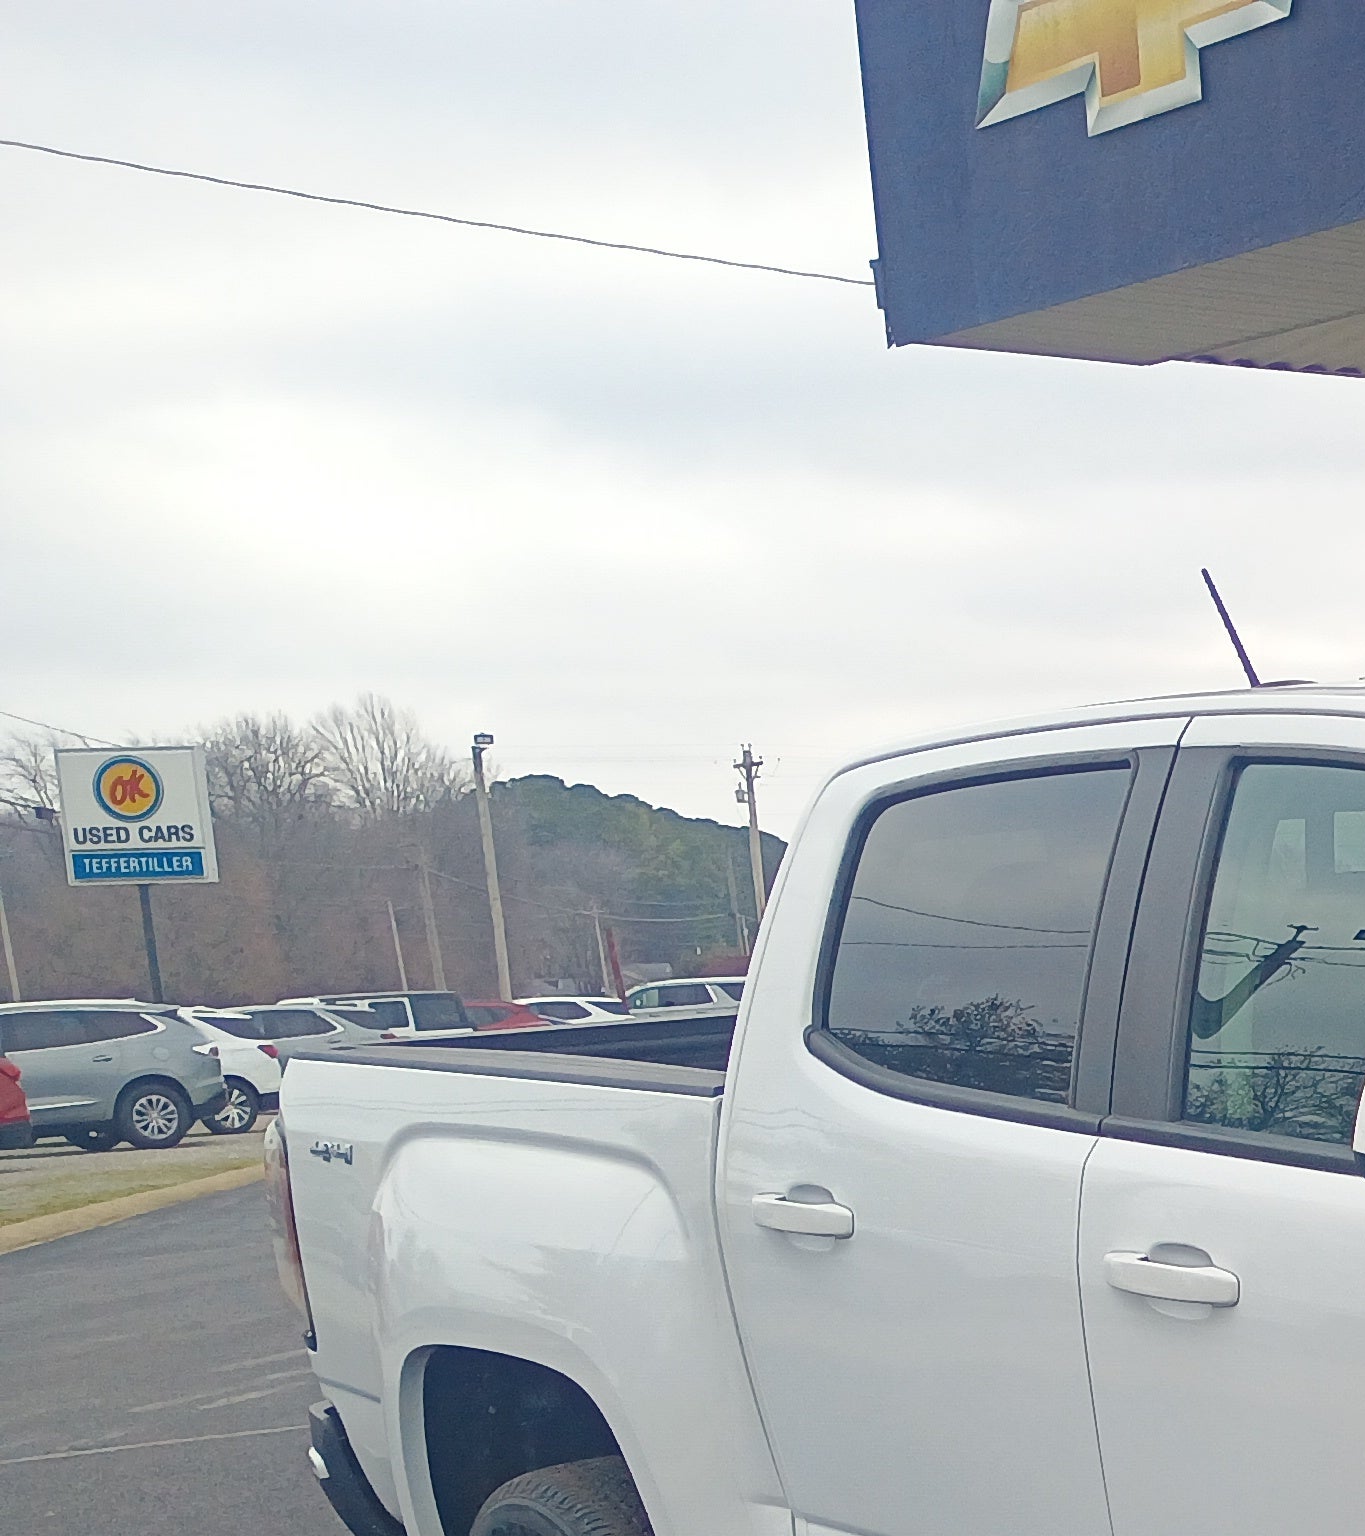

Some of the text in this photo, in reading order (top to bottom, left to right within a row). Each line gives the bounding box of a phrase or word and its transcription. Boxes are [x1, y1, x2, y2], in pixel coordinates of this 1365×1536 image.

[110, 769, 151, 806] OK
[73, 824, 195, 845] USED CARS
[83, 856, 193, 874] TEFFERTILLER
